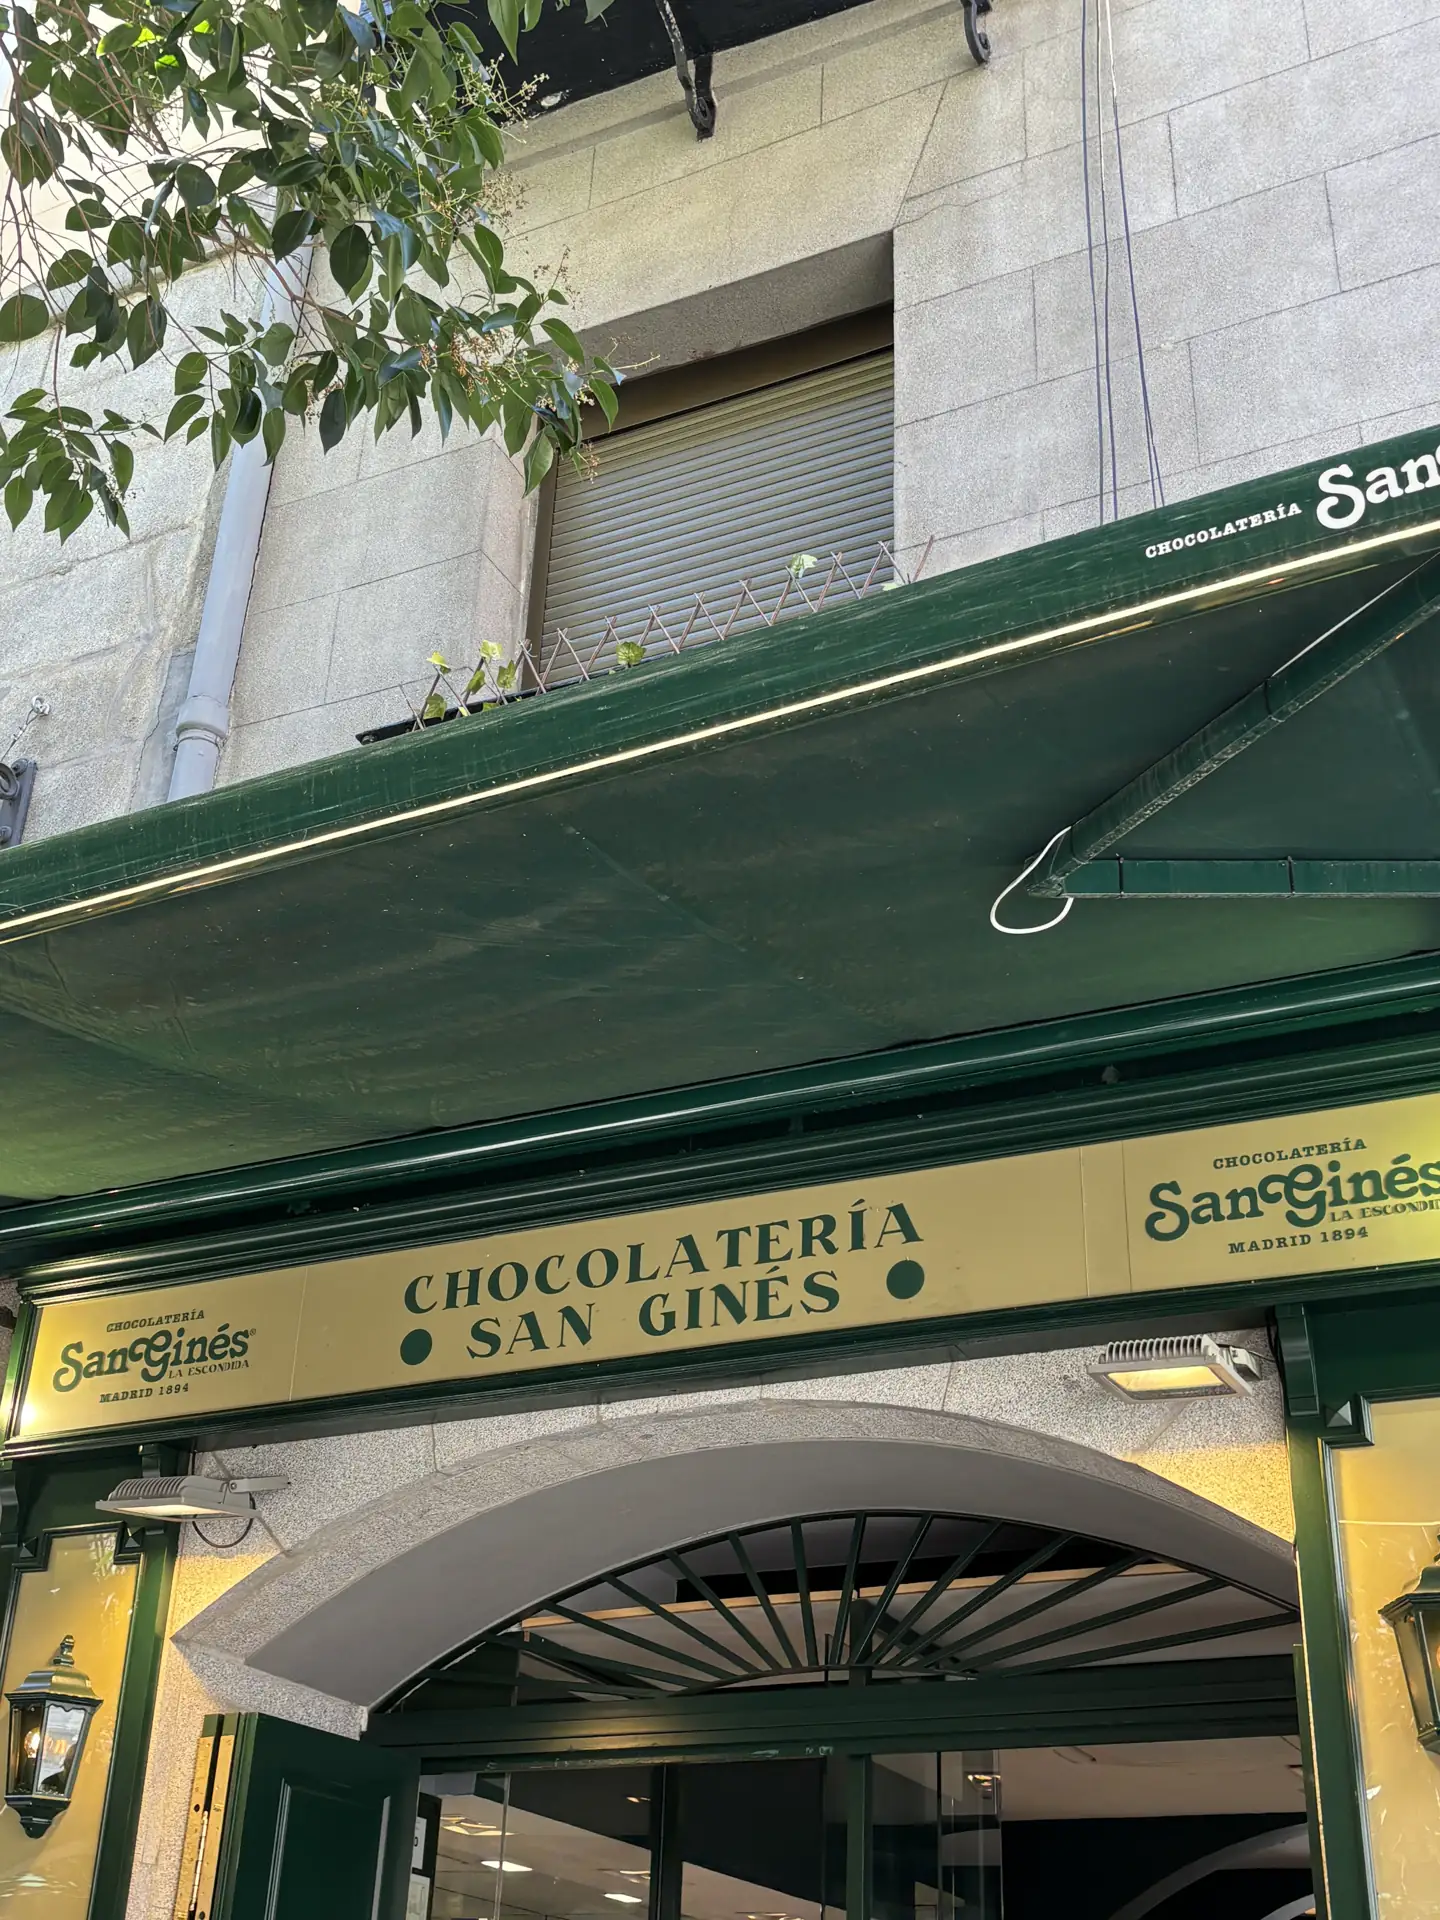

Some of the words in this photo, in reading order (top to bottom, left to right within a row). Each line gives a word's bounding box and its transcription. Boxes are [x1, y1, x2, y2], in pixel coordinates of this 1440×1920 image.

[1145, 502, 1302, 558] CHOCOLATERÍA
[1213, 1137, 1367, 1170] CHOCOLATERÍA
[1145, 1180, 1264, 1241] San
[1330, 1210, 1354, 1222] LA
[403, 1198, 924, 1314] CHOCOLATERÍA
[1228, 1233, 1312, 1254] MADRID
[1320, 1226, 1369, 1243] 1894
[106, 1308, 205, 1333] CHOCOLATERÍA
[465, 1302, 596, 1359] SAN
[638, 1265, 840, 1337] GINÉS
[52, 1341, 129, 1393] San
[168, 1369, 183, 1379] LA
[187, 1359, 250, 1376] ESCONDIDA
[99, 1387, 153, 1403] MADRID
[158, 1383, 189, 1396] 1894
